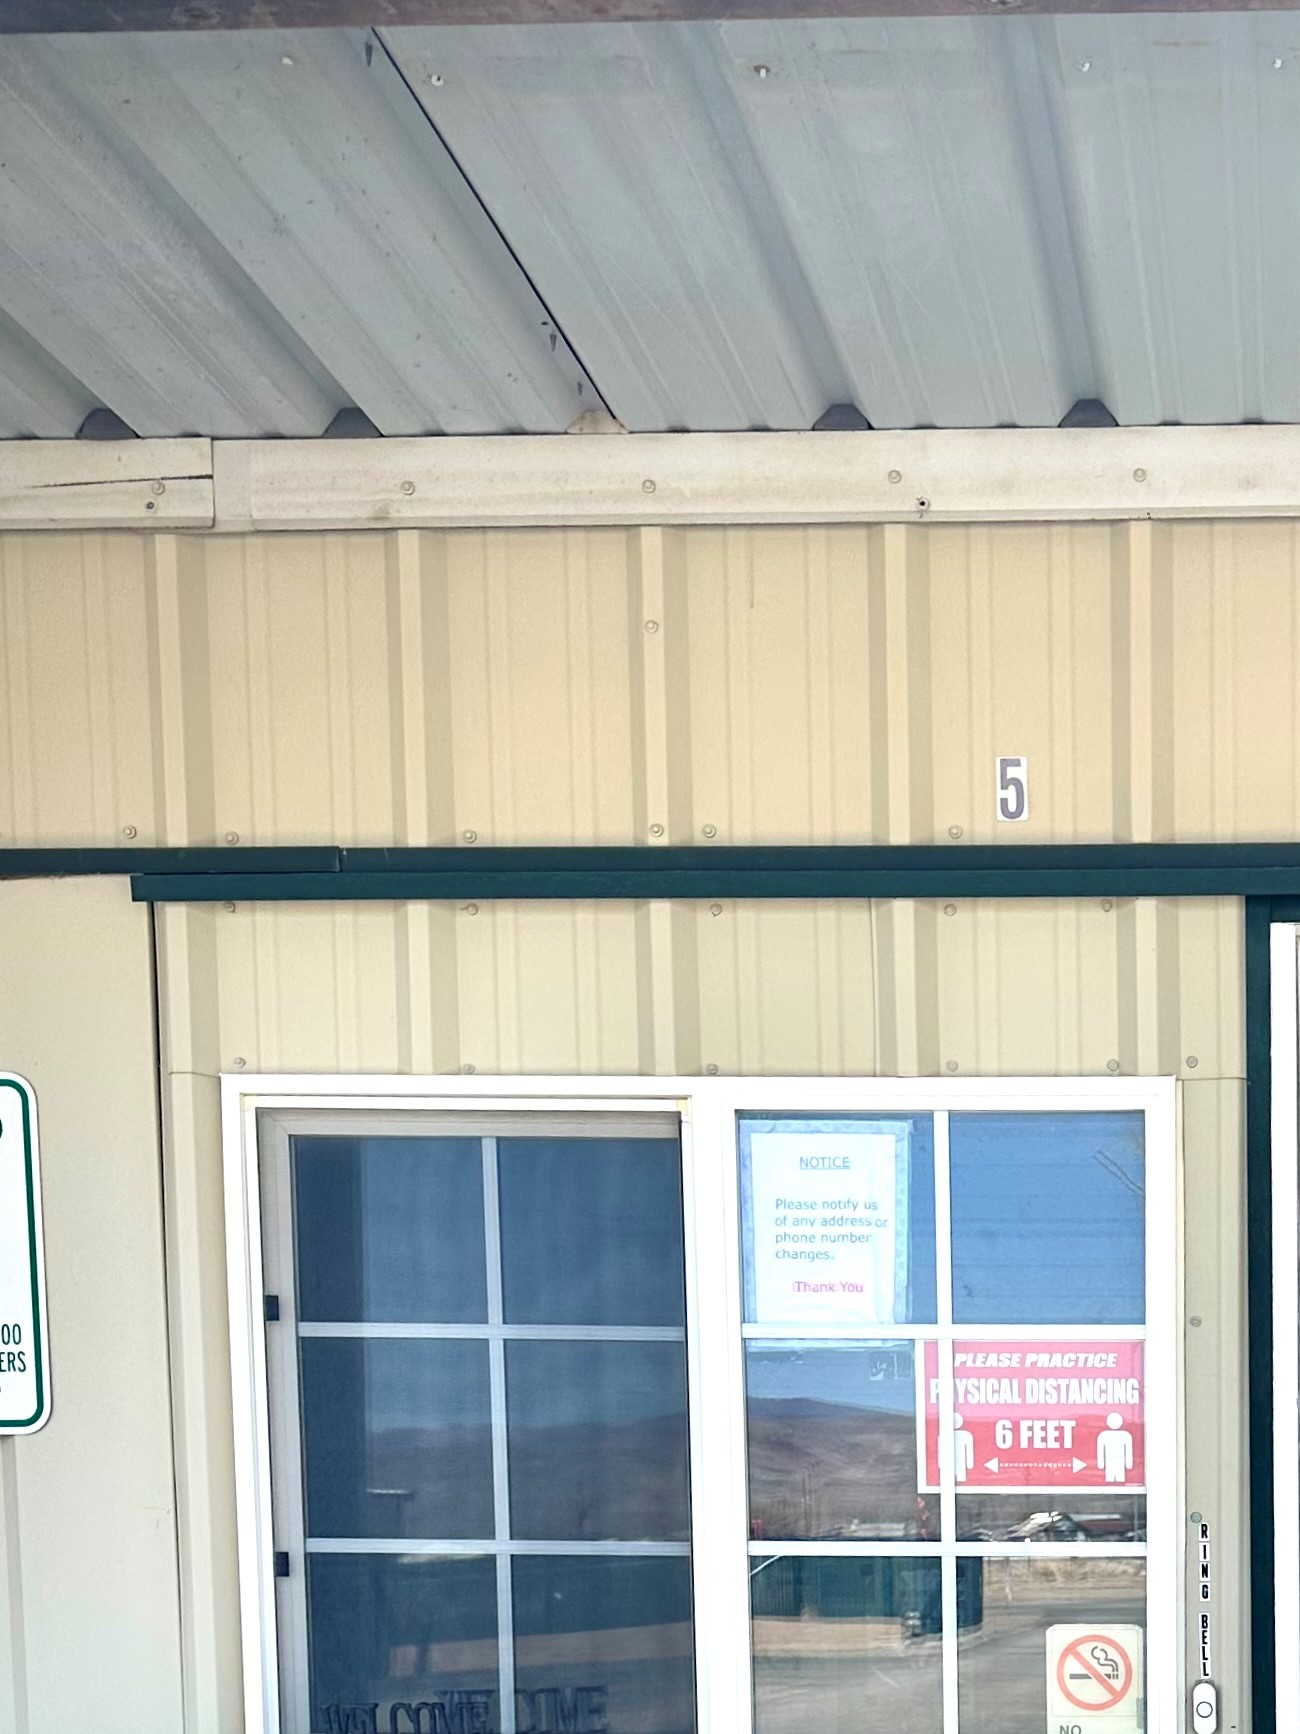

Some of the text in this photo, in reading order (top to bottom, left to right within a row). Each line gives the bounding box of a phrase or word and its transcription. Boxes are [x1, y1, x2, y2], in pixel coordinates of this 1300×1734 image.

[999, 758, 1025, 820] 5
[799, 1156, 850, 1170] NOTICE
[775, 1198, 878, 1212] Please notify us
[774, 1216, 889, 1228] of any address or
[775, 1232, 872, 1244] phone number
[775, 1249, 835, 1262] changes.
[795, 1281, 865, 1293] Thank You
[953, 1352, 1119, 1369] PLEASE PRACTICE
[930, 1378, 1140, 1405] PYSICAL DISTANCING
[995, 1419, 1077, 1450] 6 FEET
[1200, 1523, 1210, 1677] RING BELL
